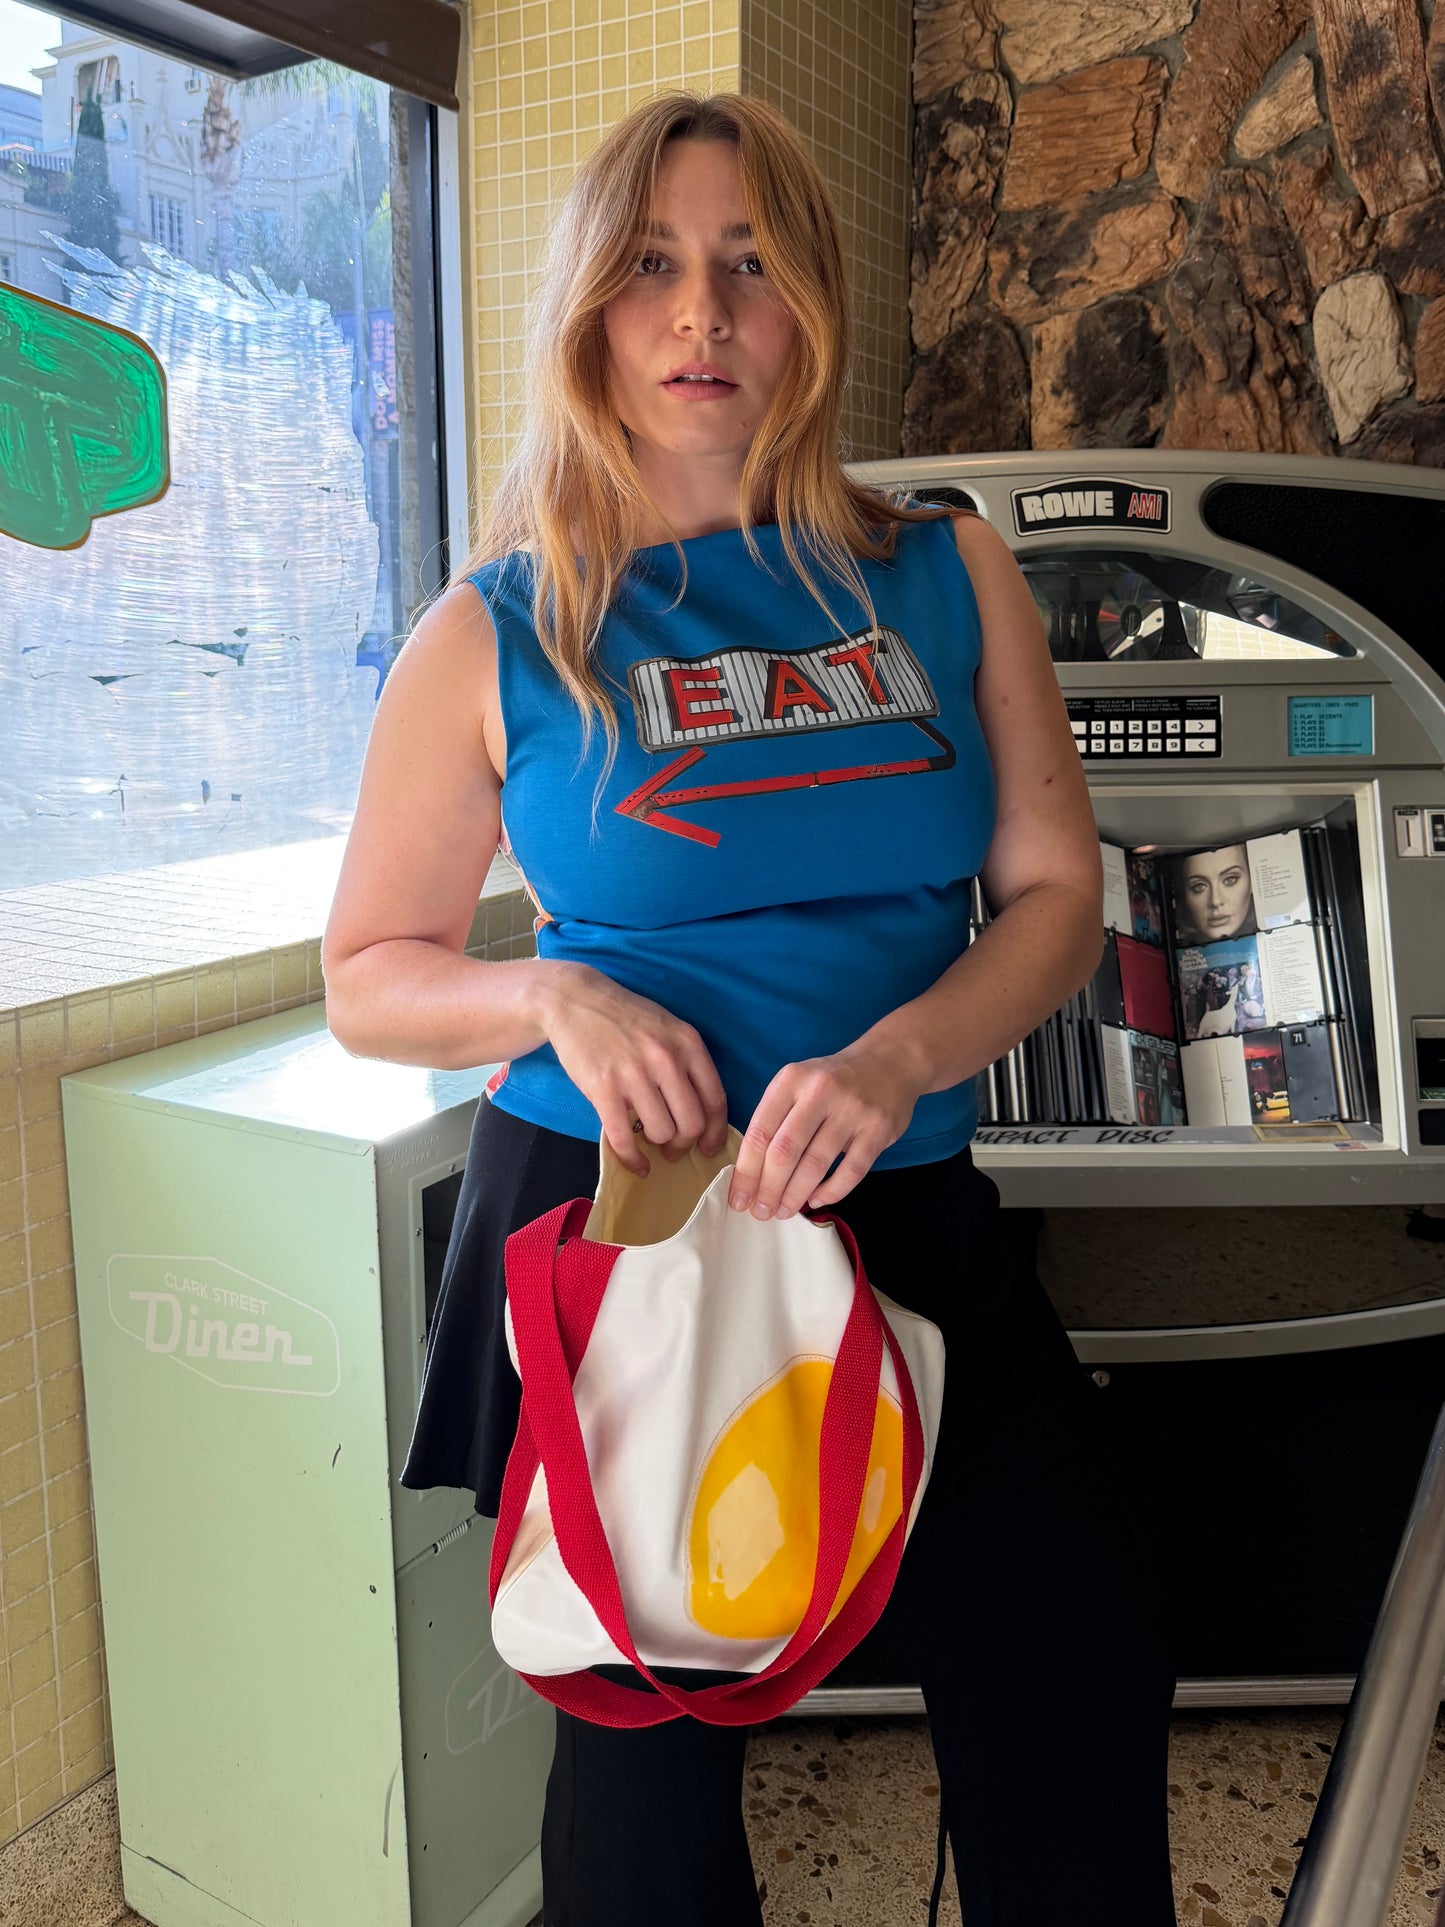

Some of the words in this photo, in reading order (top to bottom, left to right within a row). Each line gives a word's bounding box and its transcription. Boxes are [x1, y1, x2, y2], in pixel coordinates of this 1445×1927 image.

[1021, 490, 1114, 523] ROWE
[661, 639, 893, 731] EAT
[1170, 741, 1178, 749] 9
[1293, 1033, 1303, 1043] 71
[975, 1129, 1079, 1144] MPACT
[1096, 1129, 1174, 1144] DISC
[164, 1272, 208, 1299] CLARK
[212, 1287, 269, 1316] STREET
[129, 1290, 313, 1365] Diner
